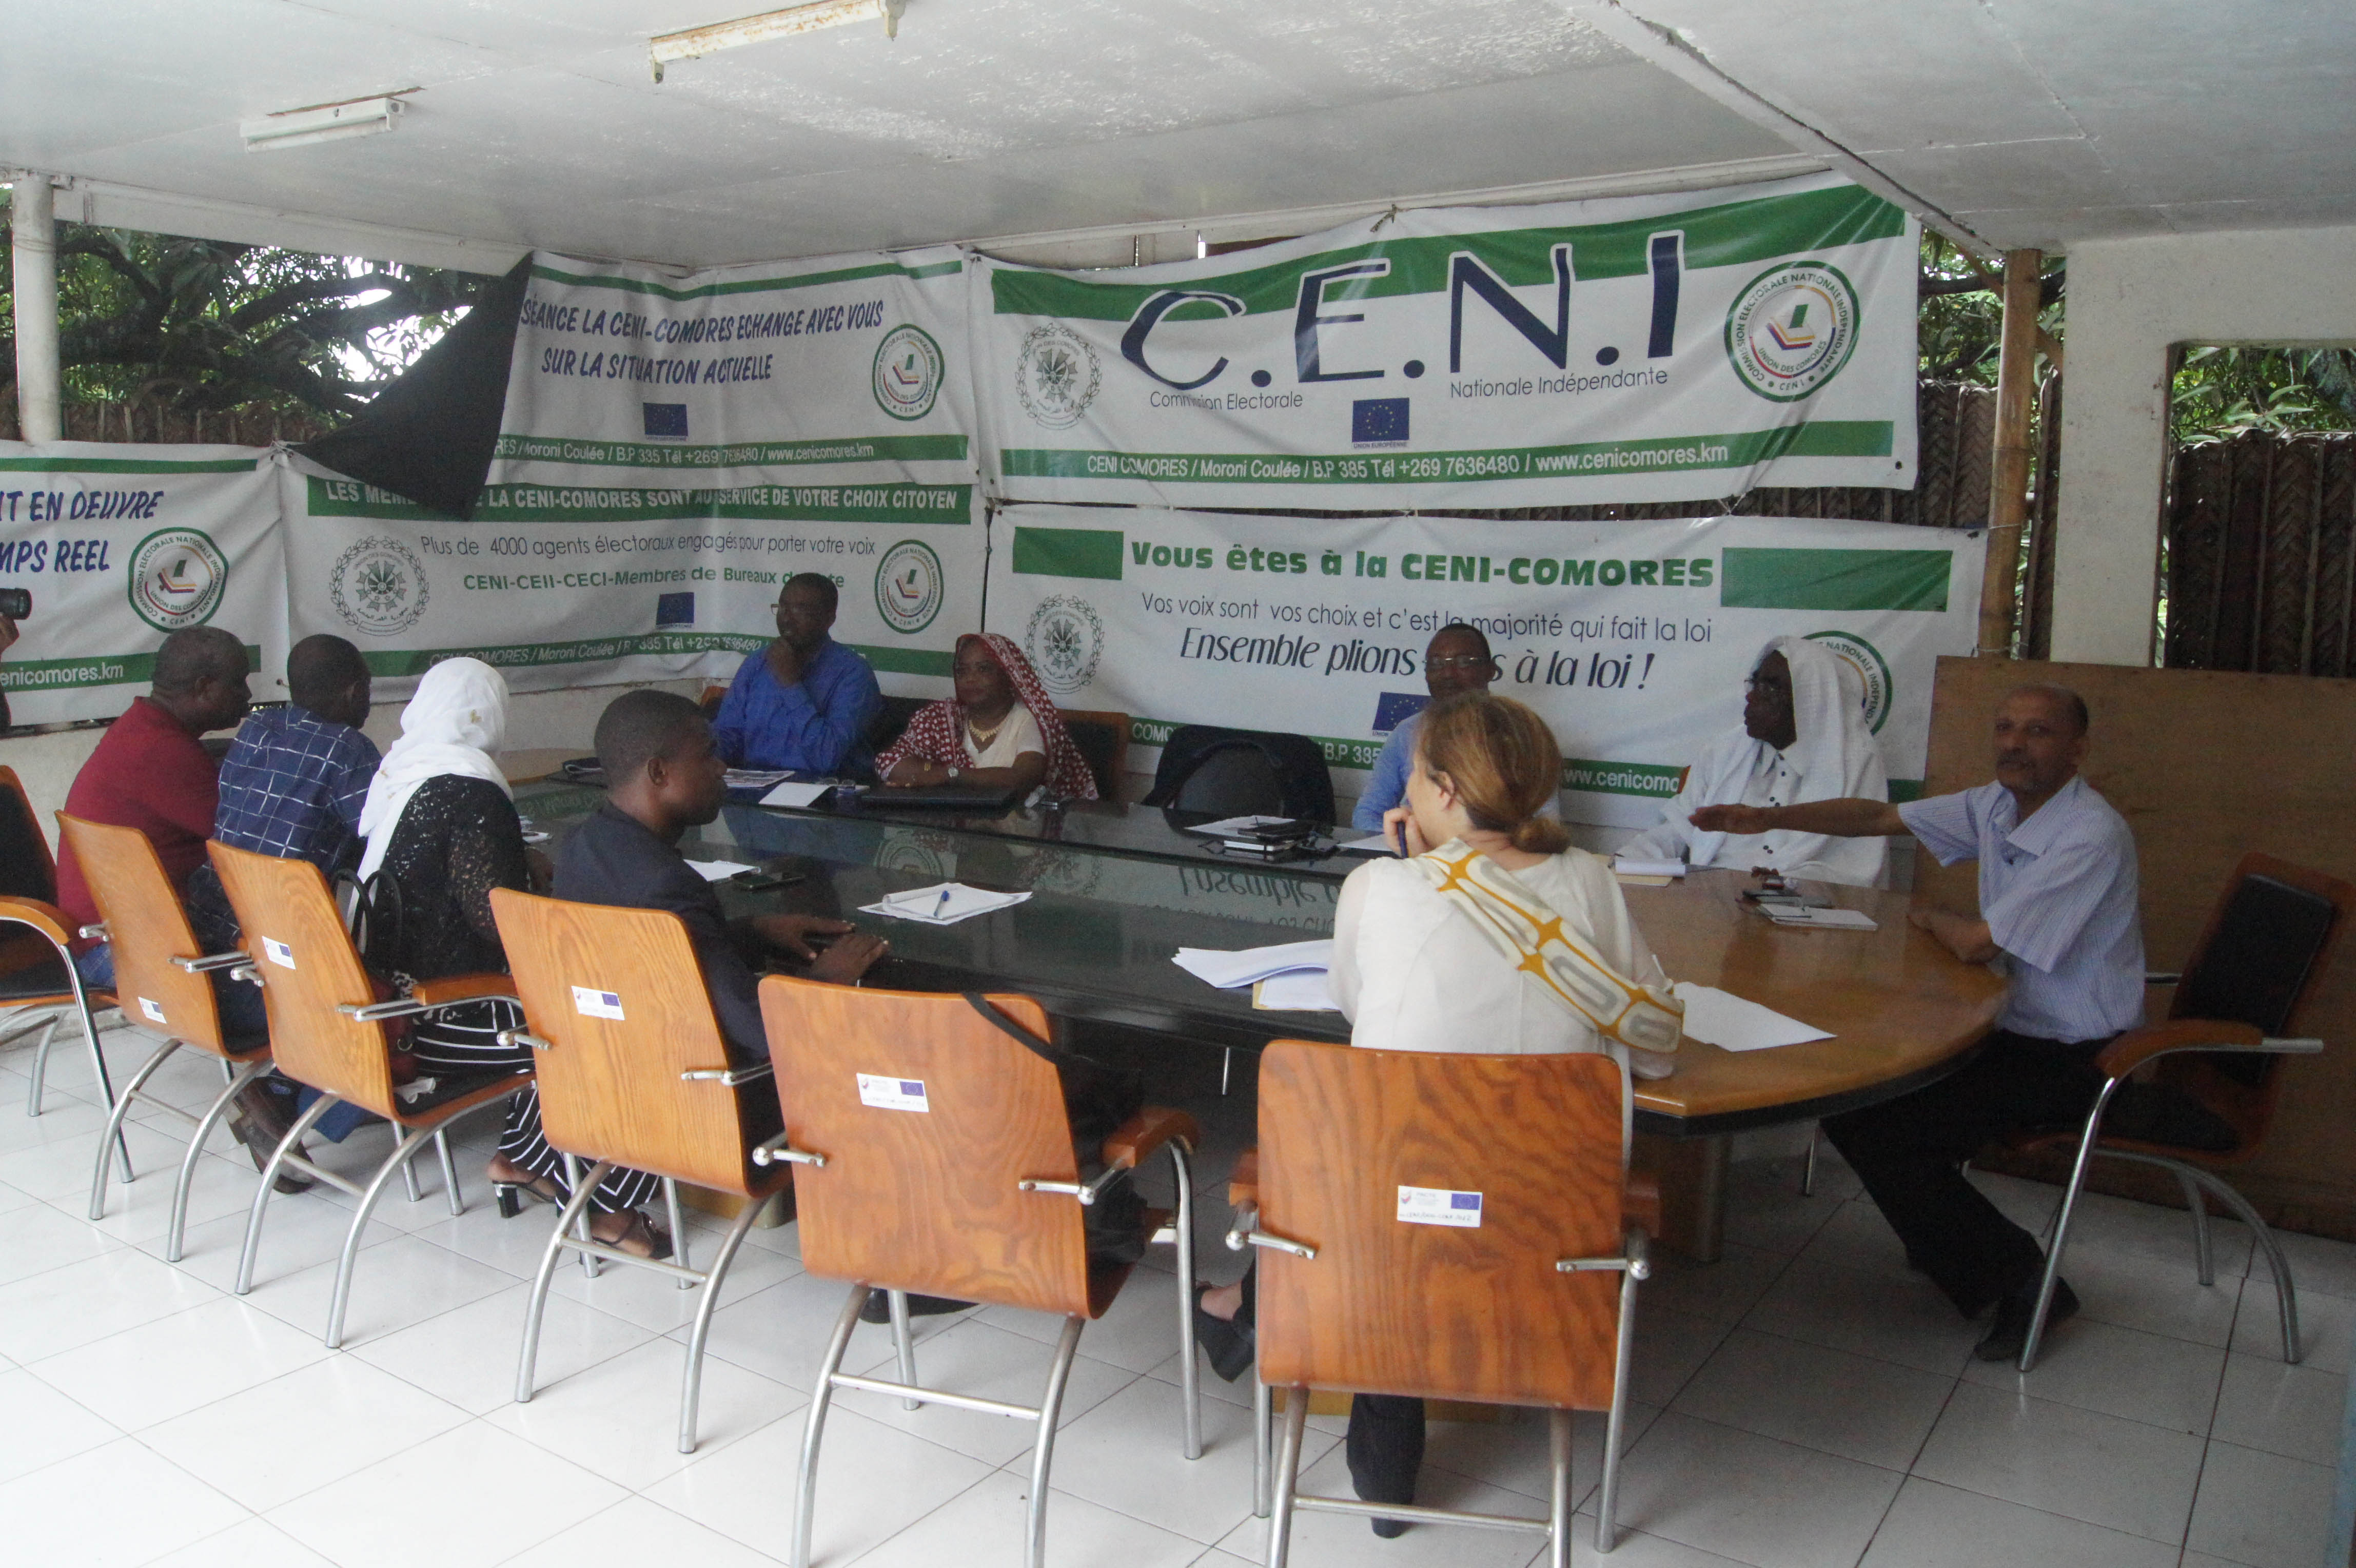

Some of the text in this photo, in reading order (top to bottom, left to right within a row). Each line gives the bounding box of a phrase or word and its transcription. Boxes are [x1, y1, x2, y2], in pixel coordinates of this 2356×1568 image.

[1791, 273, 1841, 300] NATIONALE
[582, 309, 606, 336] LA
[610, 311, 734, 343] CENI-COMORES
[737, 309, 804, 340] ECHANGE
[806, 305, 844, 335] AVEC
[847, 300, 883, 330] VOUS
[542, 347, 773, 384] SUR LA SITUATION ACTUELLE
[1758, 348, 1779, 369] UNION
[1796, 341, 1827, 371] COMORES
[1450, 367, 1667, 398] Nationale Indépendante
[1779, 379, 1804, 390] CENI
[1227, 391, 1303, 410] Electorale
[564, 443, 604, 460] Coulée
[685, 449, 718, 463] +269
[768, 442, 873, 460] www.cenicomores.km
[1087, 455, 1117, 472] CENI
[1121, 457, 1188, 476] COMORES
[1200, 459, 1247, 477] Moroni
[1250, 459, 1301, 478] Coulée
[1313, 460, 1334, 478] B.P
[1339, 460, 1366, 478] 385
[1371, 459, 1394, 477] Tél
[1399, 459, 1441, 477] +269
[1445, 455, 1519, 476] 7636480
[1536, 443, 1728, 471] www.cenicomores.km
[30, 491, 64, 521] EN
[326, 482, 359, 502] LES
[489, 489, 509, 507] LA
[515, 489, 642, 508] CENI-COMORES
[647, 489, 692, 506] SONT
[719, 488, 768, 505] SERVICE
[772, 489, 789, 506] DE
[793, 488, 838, 507] VOTRE
[843, 489, 888, 508] CHOIX
[892, 490, 957, 509] CITOYEN
[54, 540, 110, 572] REEL
[421, 531, 875, 559] Plus de 4000 agents électoraux engagés pour porter votre voix
[691, 567, 717, 580] de
[724, 568, 776, 584] Bureaux
[1131, 542, 1714, 587] Vous êtes à la CENI-COMORES
[1142, 592, 1172, 614] Vos
[1179, 596, 1213, 616] voix
[1220, 599, 1259, 619] sont
[1270, 605, 1302, 622] vos
[1308, 603, 1358, 626] choix
[1363, 607, 1382, 629] et
[1389, 607, 1439, 631] c'est
[1472, 614, 1563, 639] majorité
[1572, 616, 1603, 642] qui
[1612, 616, 1647, 640] fait
[1655, 617, 1676, 641] la
[1686, 618, 1711, 642] loi
[538, 645, 576, 661] Moroni
[1180, 627, 1320, 668] Ensemble
[1325, 639, 1417, 676] plions
[1515, 649, 1539, 683] à
[1546, 651, 1578, 685] la
[1587, 652, 1633, 688] loi
[1827, 641, 1873, 672] NATIONALE
[0, 662, 124, 686] enicomores.km
